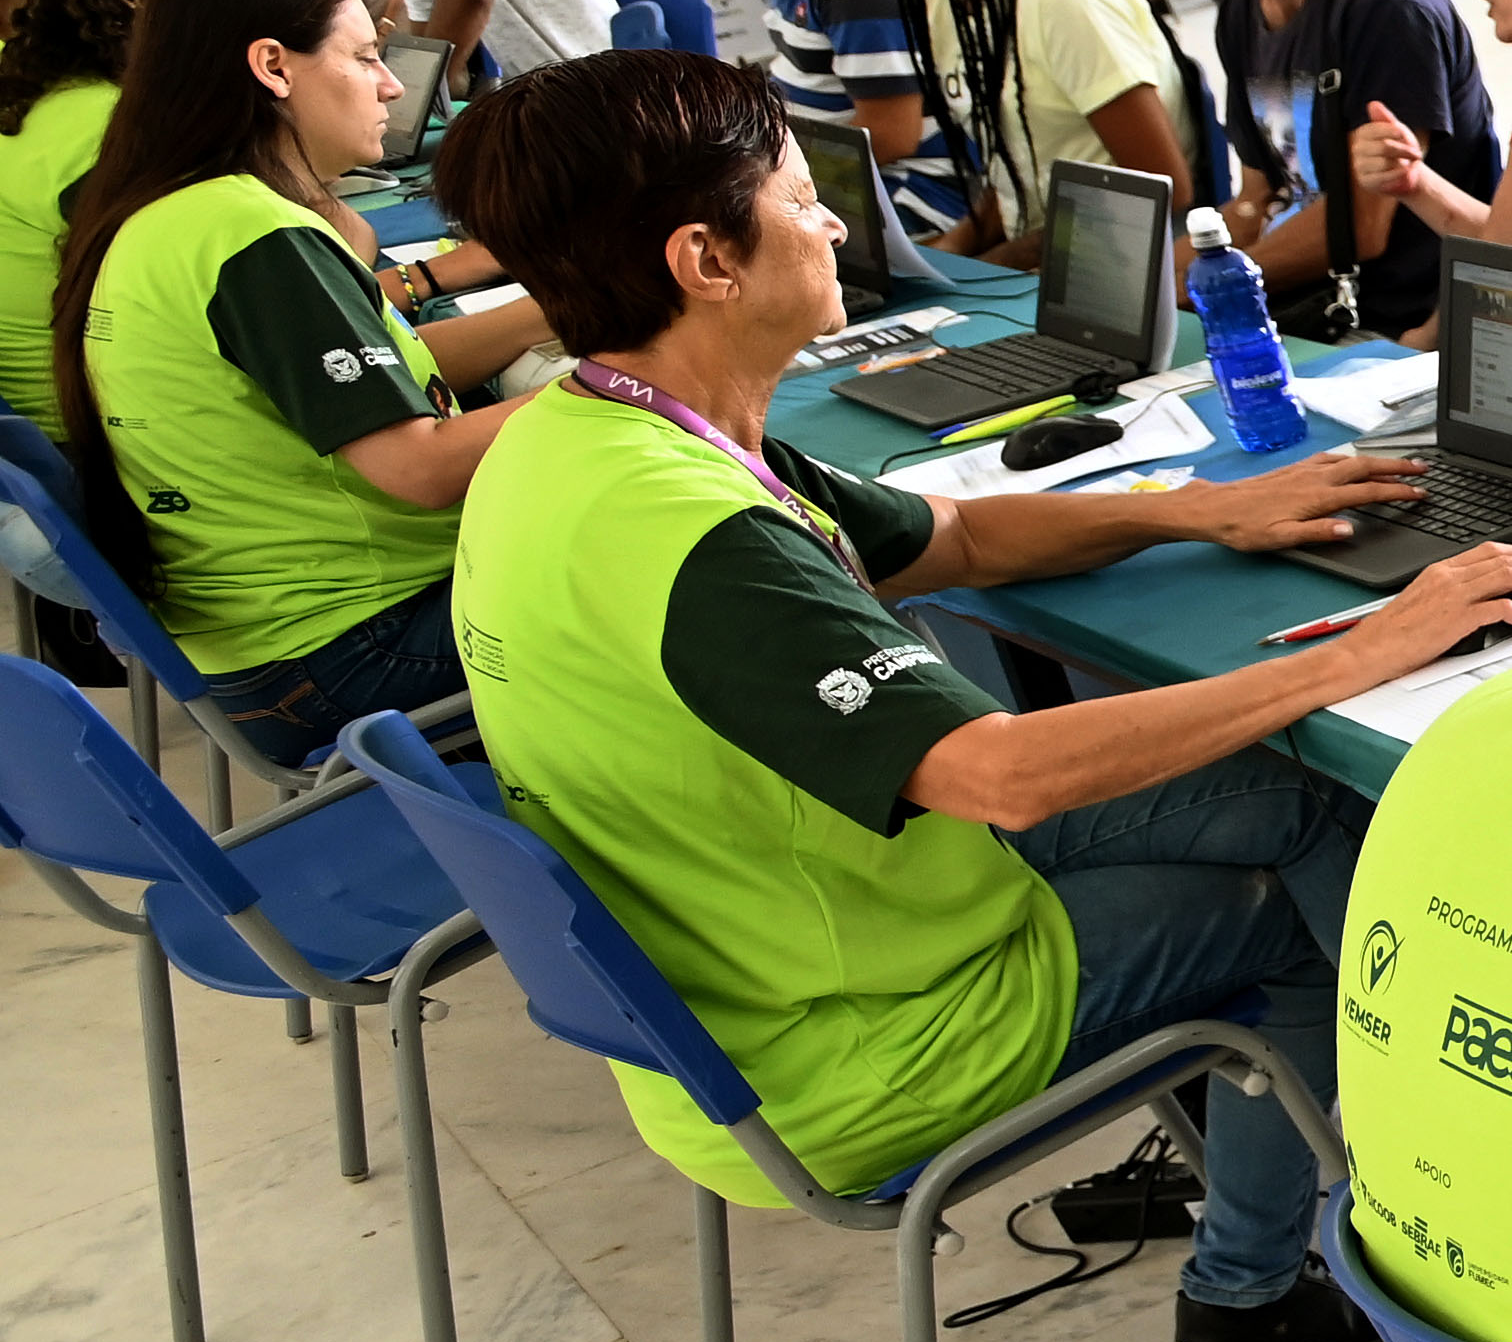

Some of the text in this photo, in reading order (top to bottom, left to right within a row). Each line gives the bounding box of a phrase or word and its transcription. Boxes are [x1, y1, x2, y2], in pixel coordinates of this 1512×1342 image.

[1344, 992, 1392, 1045] VEMSER
[1414, 1155, 1452, 1189] APOIO
[1401, 1220, 1442, 1258] SEBRAE
